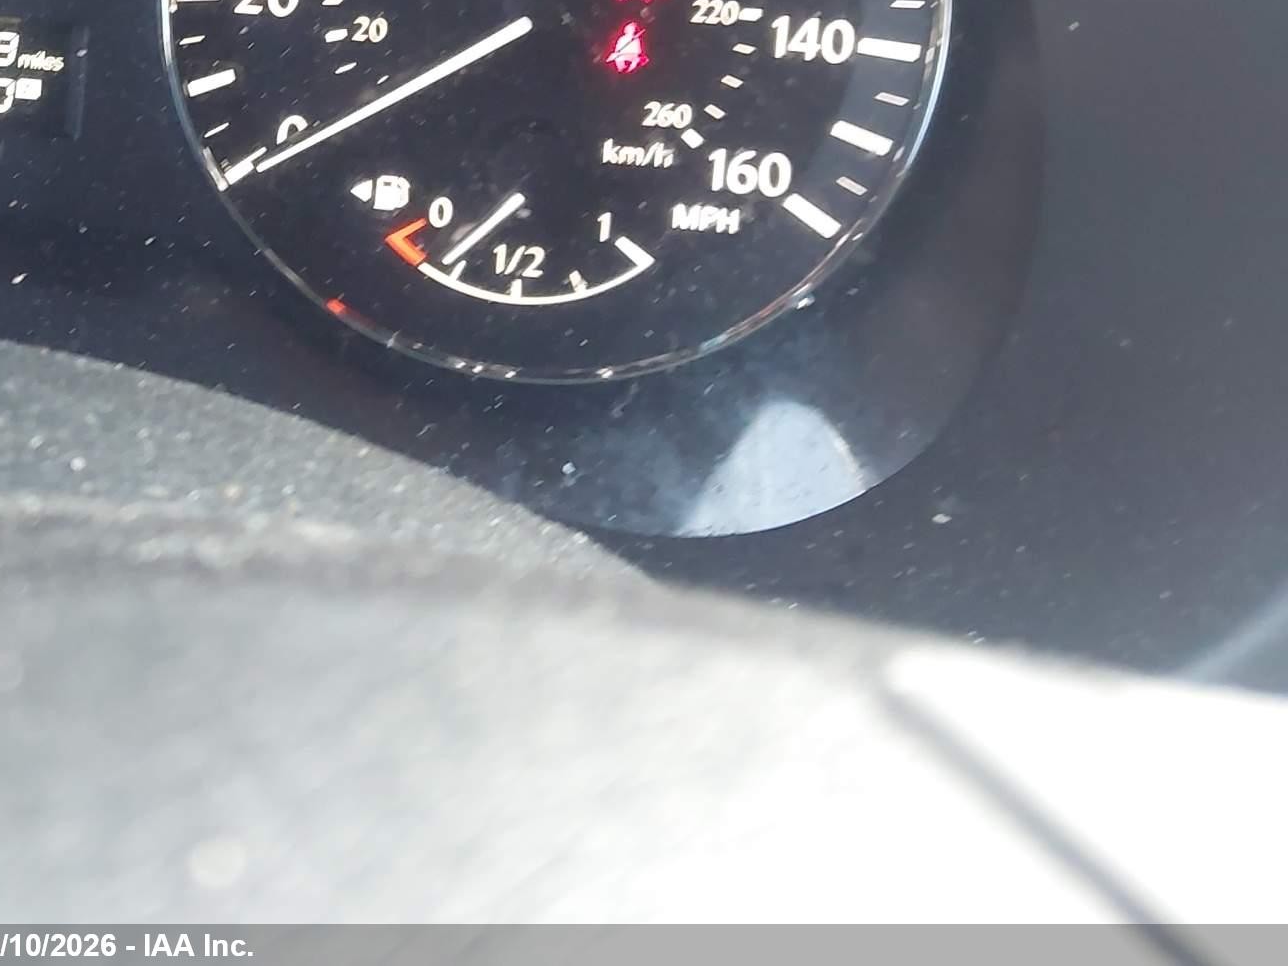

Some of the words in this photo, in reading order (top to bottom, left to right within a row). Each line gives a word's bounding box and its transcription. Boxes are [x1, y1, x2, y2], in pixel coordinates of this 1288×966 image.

[351, 16, 389, 44] 20
[770, 14, 856, 65] 140
[17, 51, 65, 72] miles
[641, 101, 693, 129] 260
[601, 138, 675, 169] km/h
[707, 147, 792, 198] 160
[428, 196, 454, 229] 0
[596, 211, 612, 242] 1
[670, 203, 741, 234] MPH
[492, 243, 546, 278] 1/2
